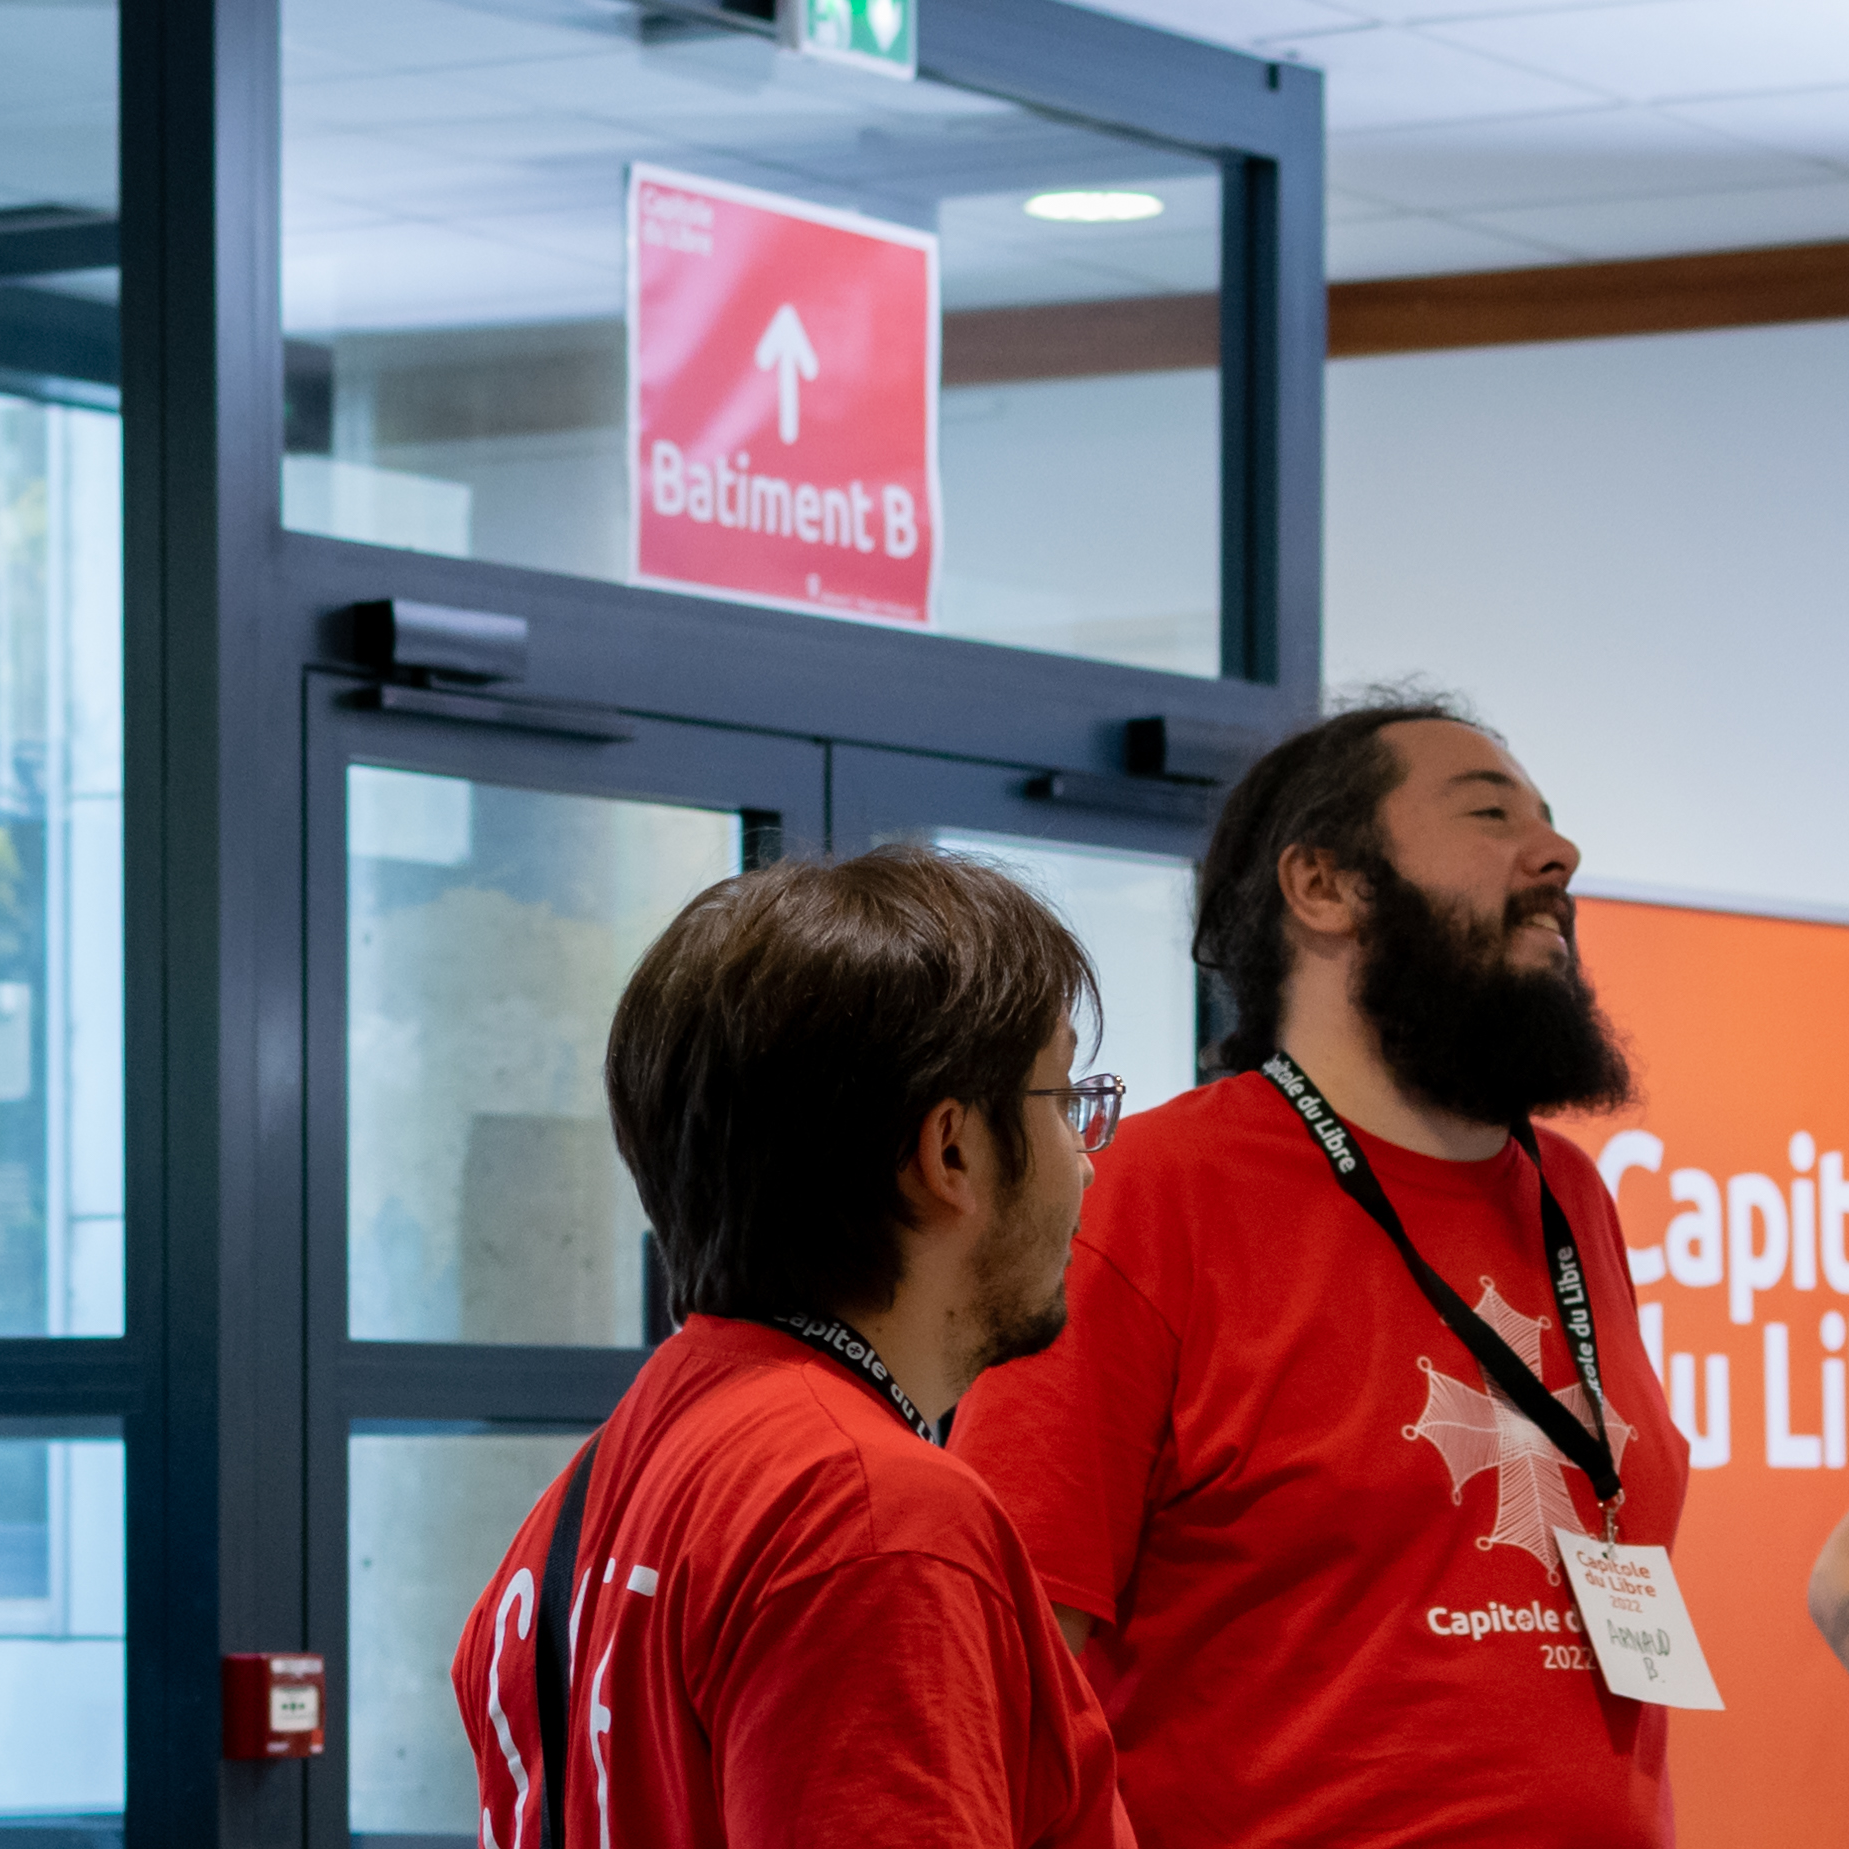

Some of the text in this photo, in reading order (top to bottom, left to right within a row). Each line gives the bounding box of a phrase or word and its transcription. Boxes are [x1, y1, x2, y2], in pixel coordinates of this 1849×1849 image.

[652, 440, 918, 560] Batiment B
[1315, 1117, 1356, 1175] Libre
[1576, 1550, 1651, 1579] Capitole
[1585, 1570, 1657, 1598] du Libre
[1427, 1600, 1561, 1641] Capitole
[1540, 1644, 1597, 1671] 2022
